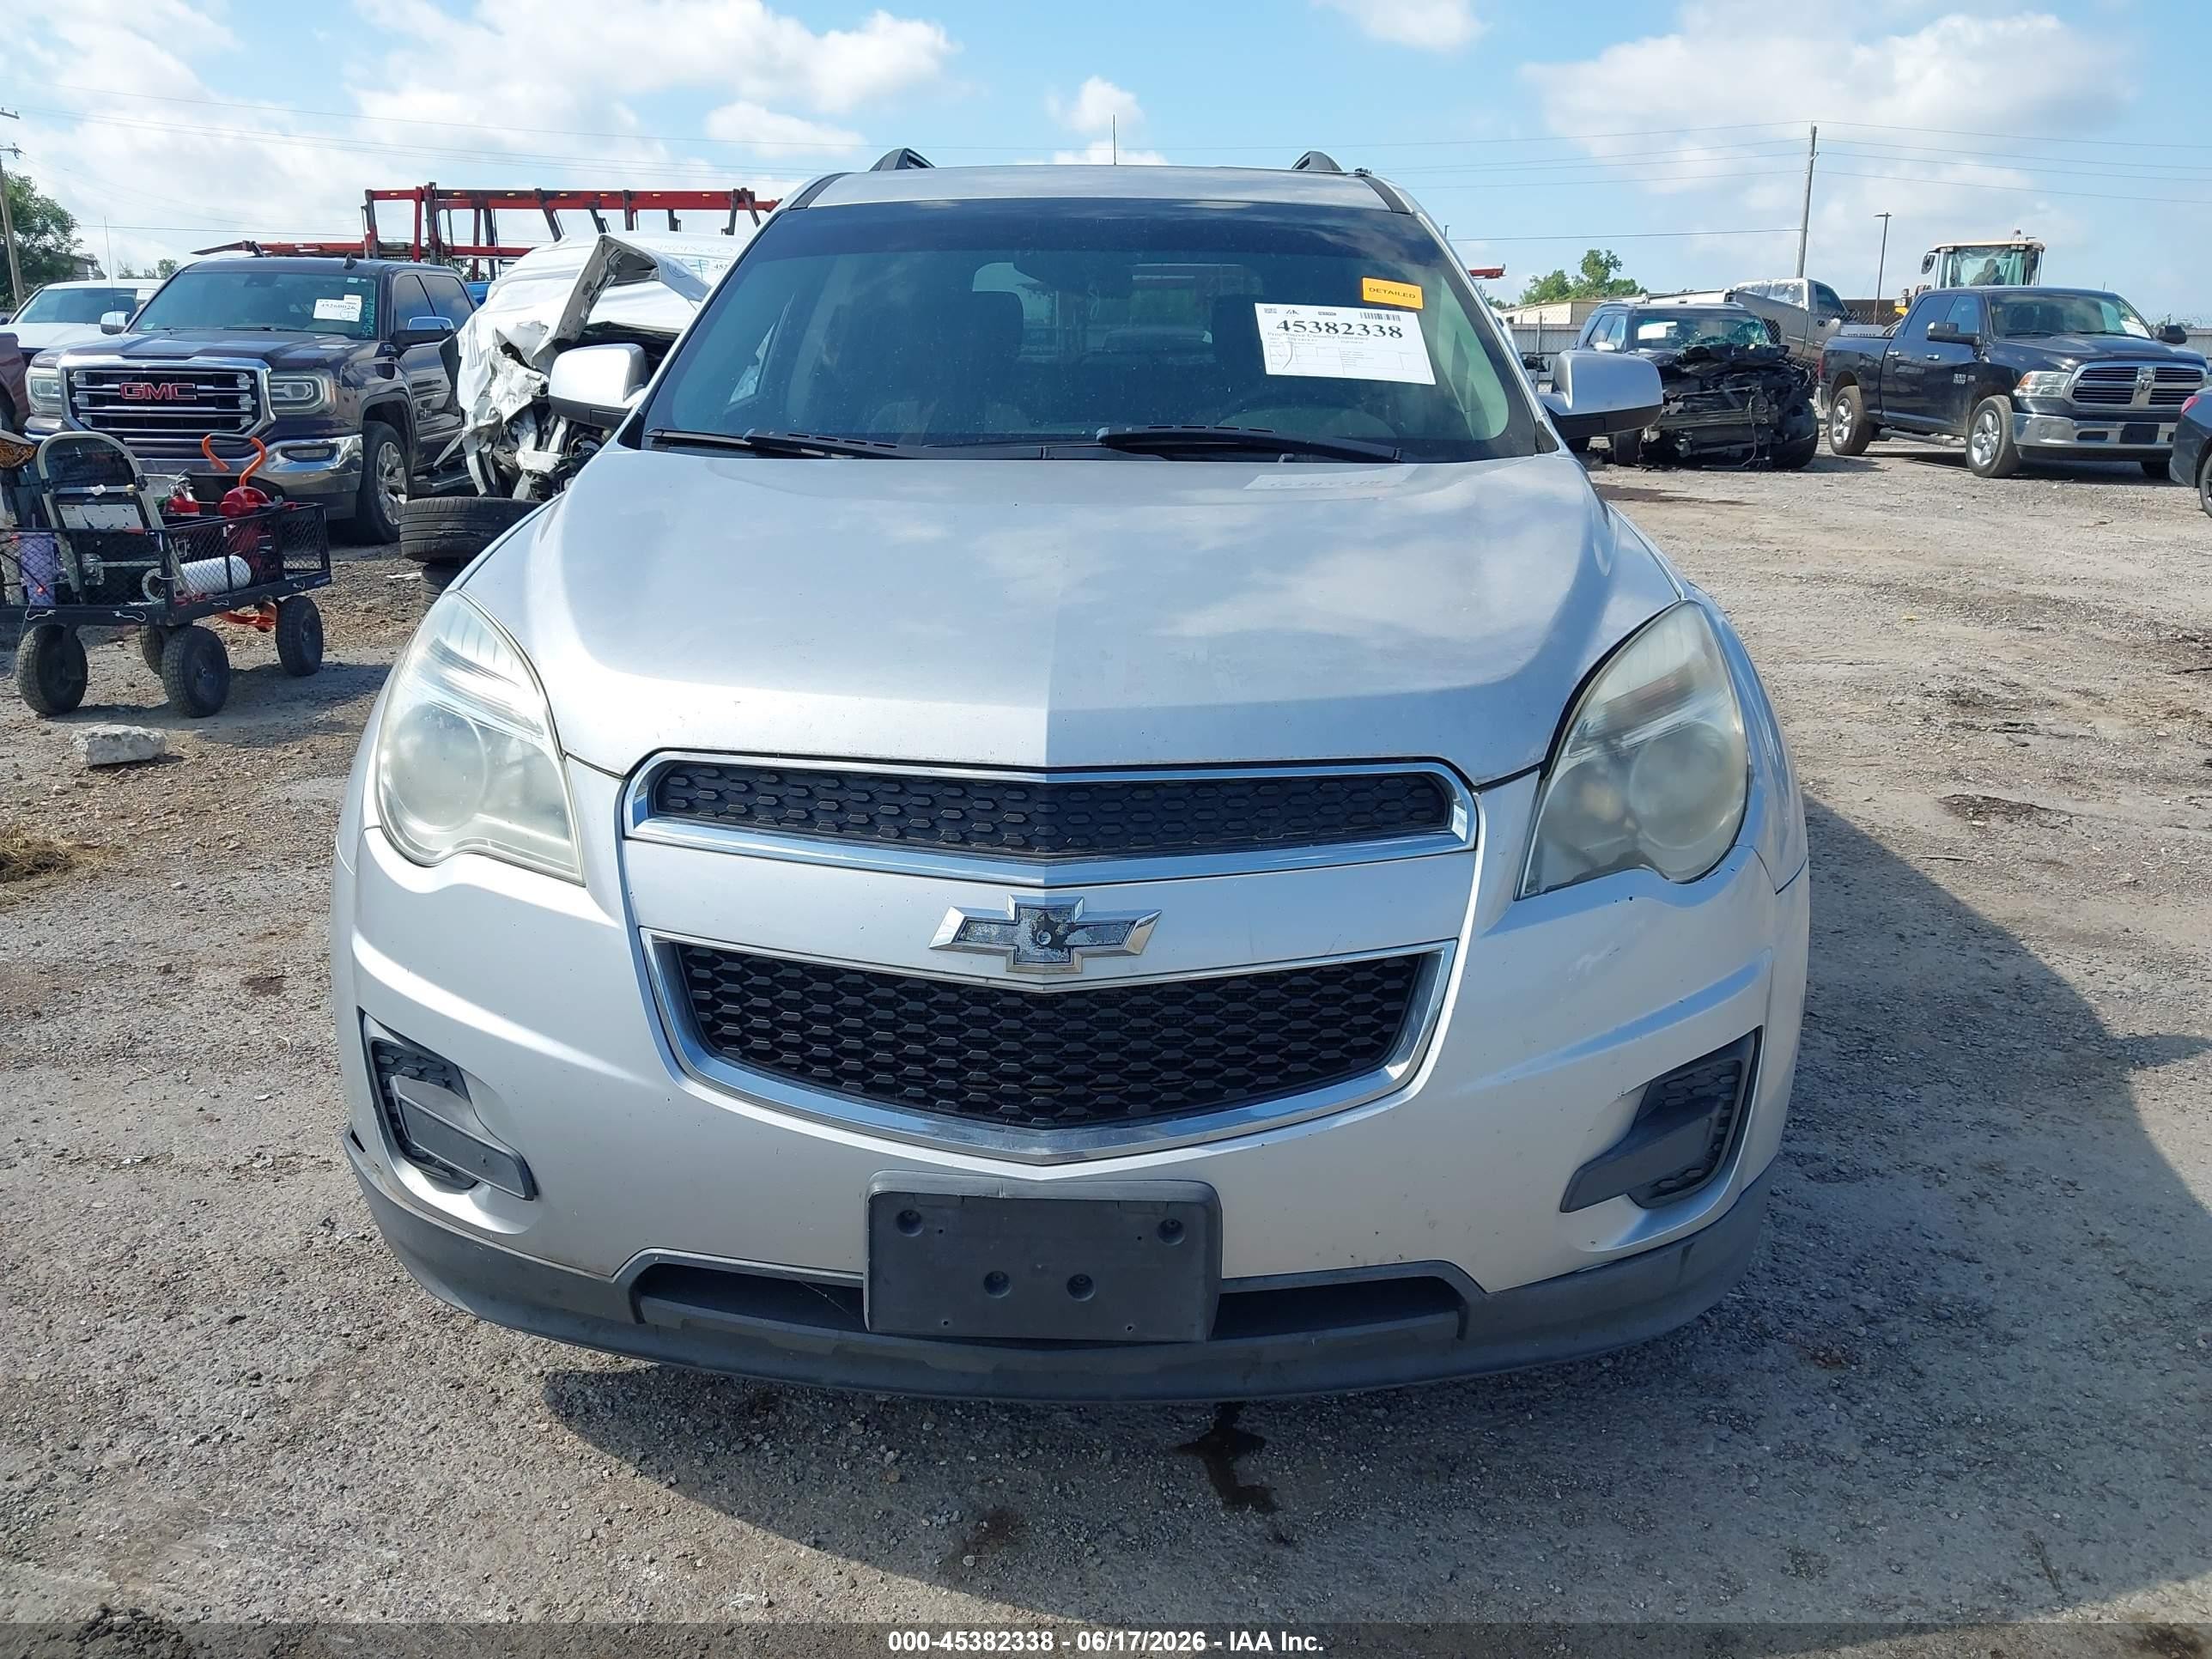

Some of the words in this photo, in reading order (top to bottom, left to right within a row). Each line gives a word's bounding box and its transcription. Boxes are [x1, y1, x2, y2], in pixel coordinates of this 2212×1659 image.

[1369, 287, 1416, 299] DETAILED
[1276, 319, 1403, 339] 45382338
[120, 382, 198, 400] GMC
